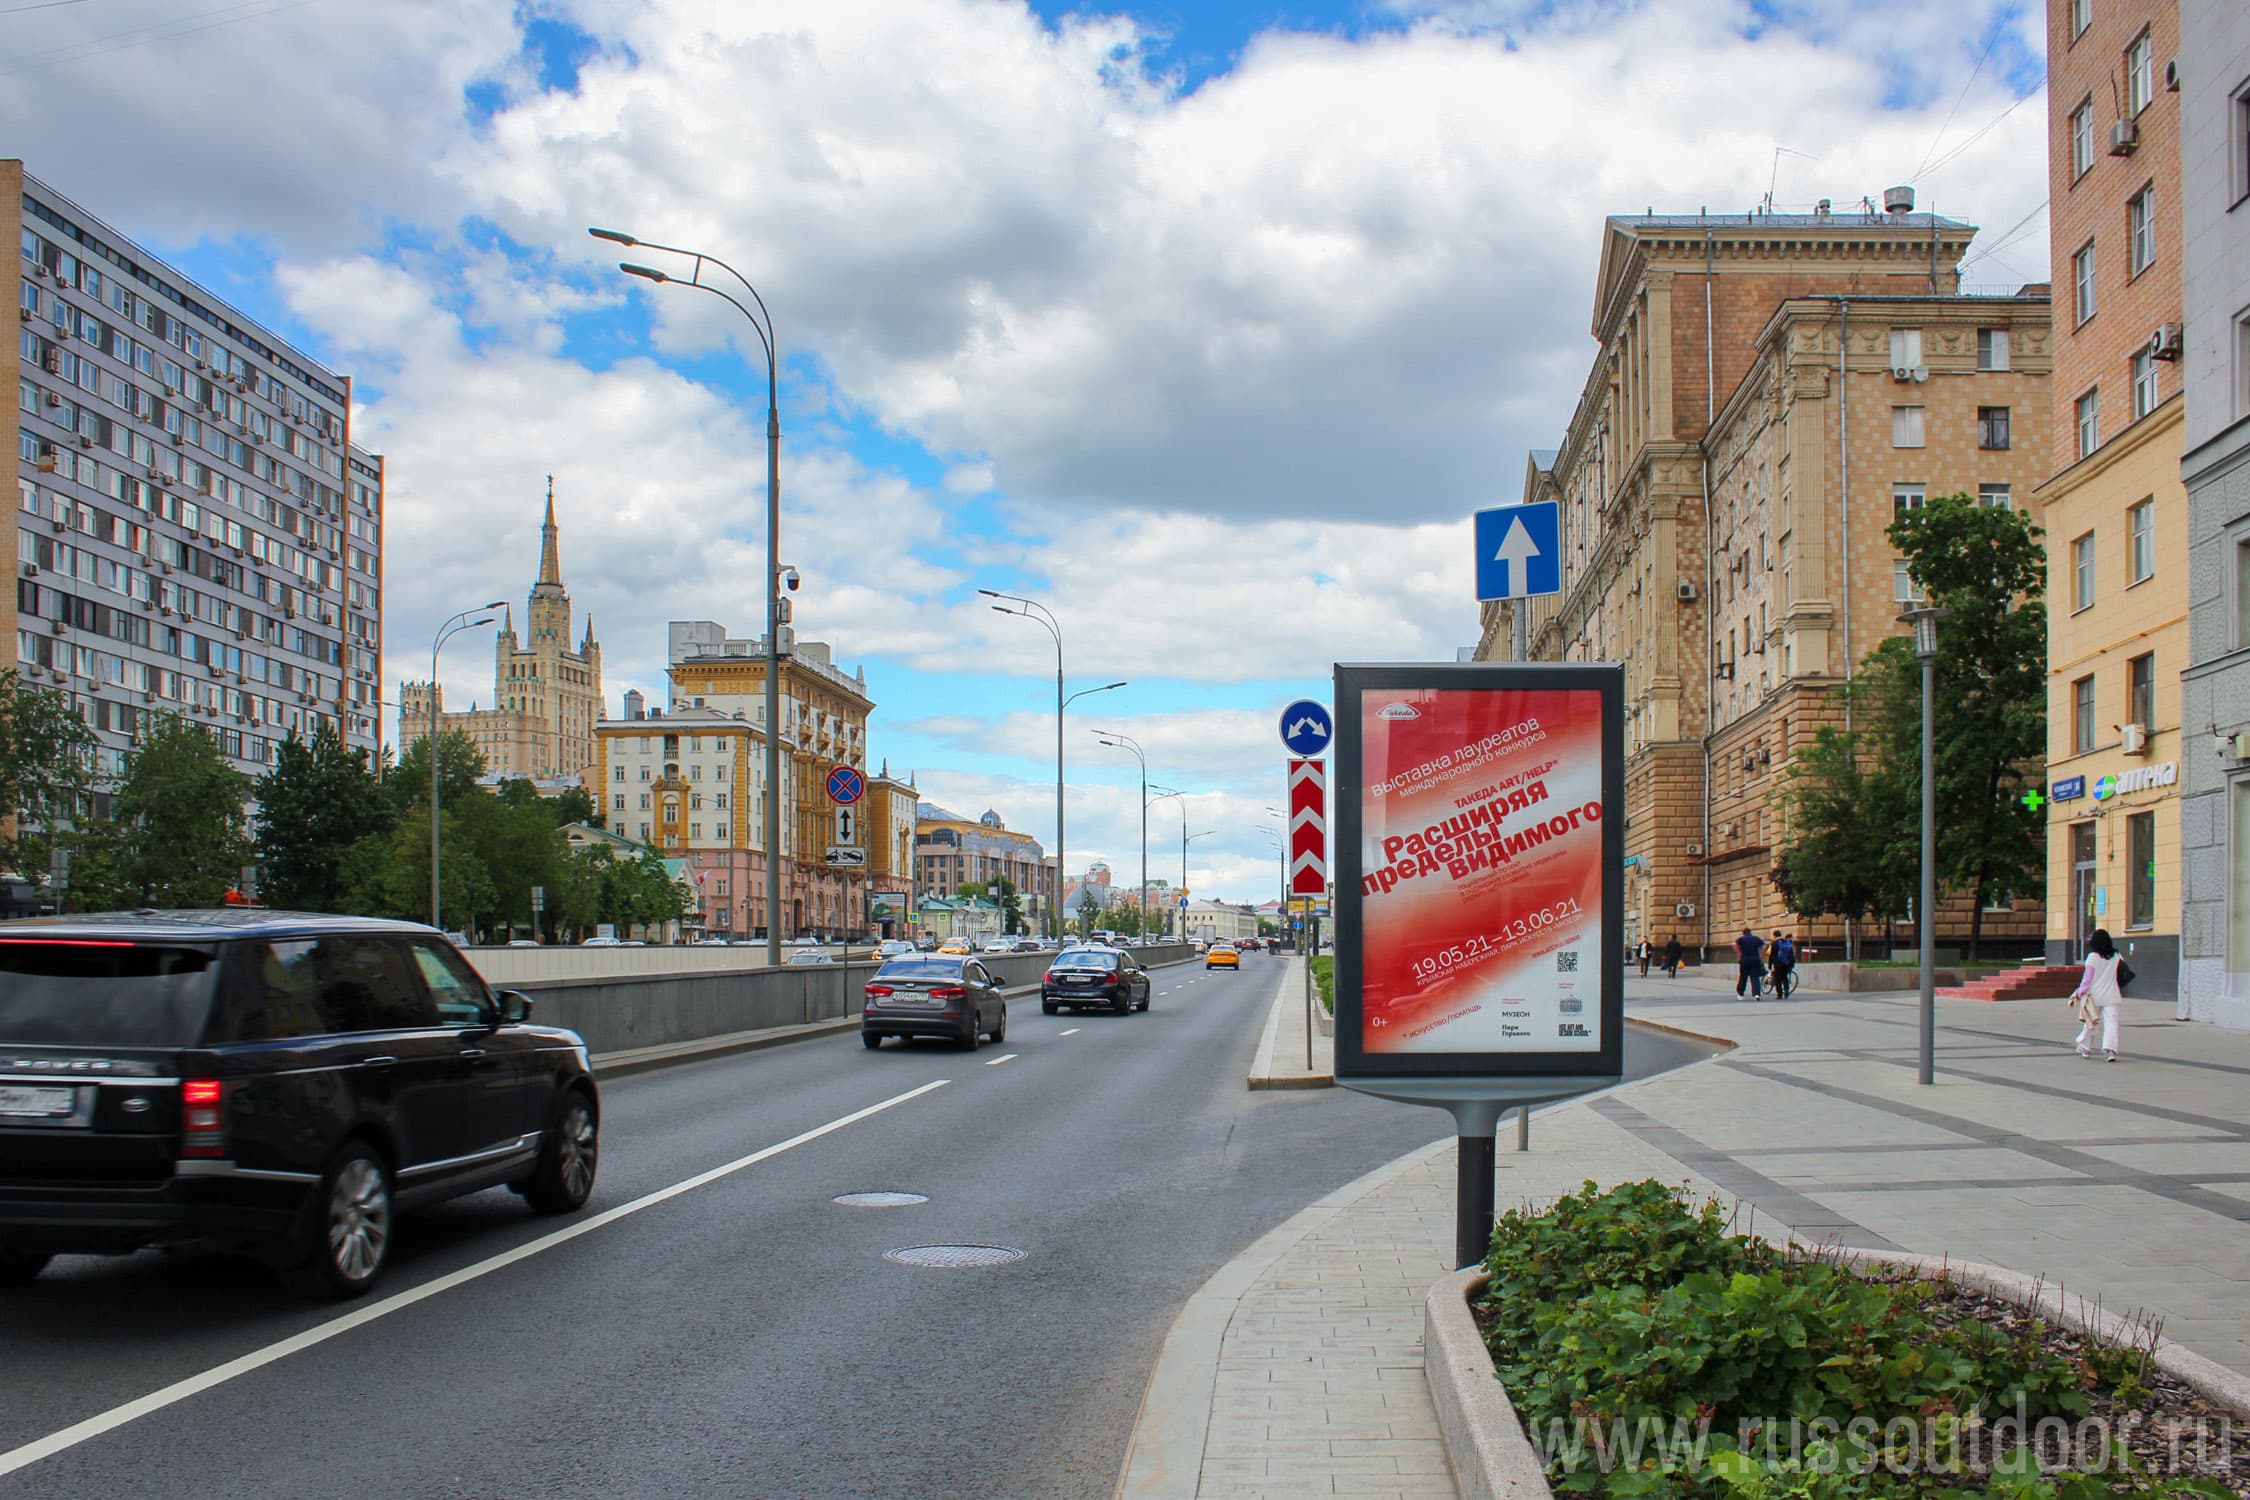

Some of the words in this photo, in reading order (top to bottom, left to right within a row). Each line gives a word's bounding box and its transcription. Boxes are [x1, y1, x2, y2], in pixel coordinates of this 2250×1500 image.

[1371, 753, 1452, 798] выставка
[1455, 717, 1540, 764] лауреатов
[1399, 753, 1494, 799] международного
[1495, 730, 1547, 758] конкурса
[2115, 760, 2178, 795] аптека
[1380, 780, 1549, 864] Расширяя
[1446, 801, 1602, 881] видимого
[1362, 823, 1502, 896] пределы
[1416, 966, 1455, 987] КРЫМСКАЯ
[1518, 926, 1553, 946] ИСКУССТВ
[1372, 1016, 1389, 1028] 0+
